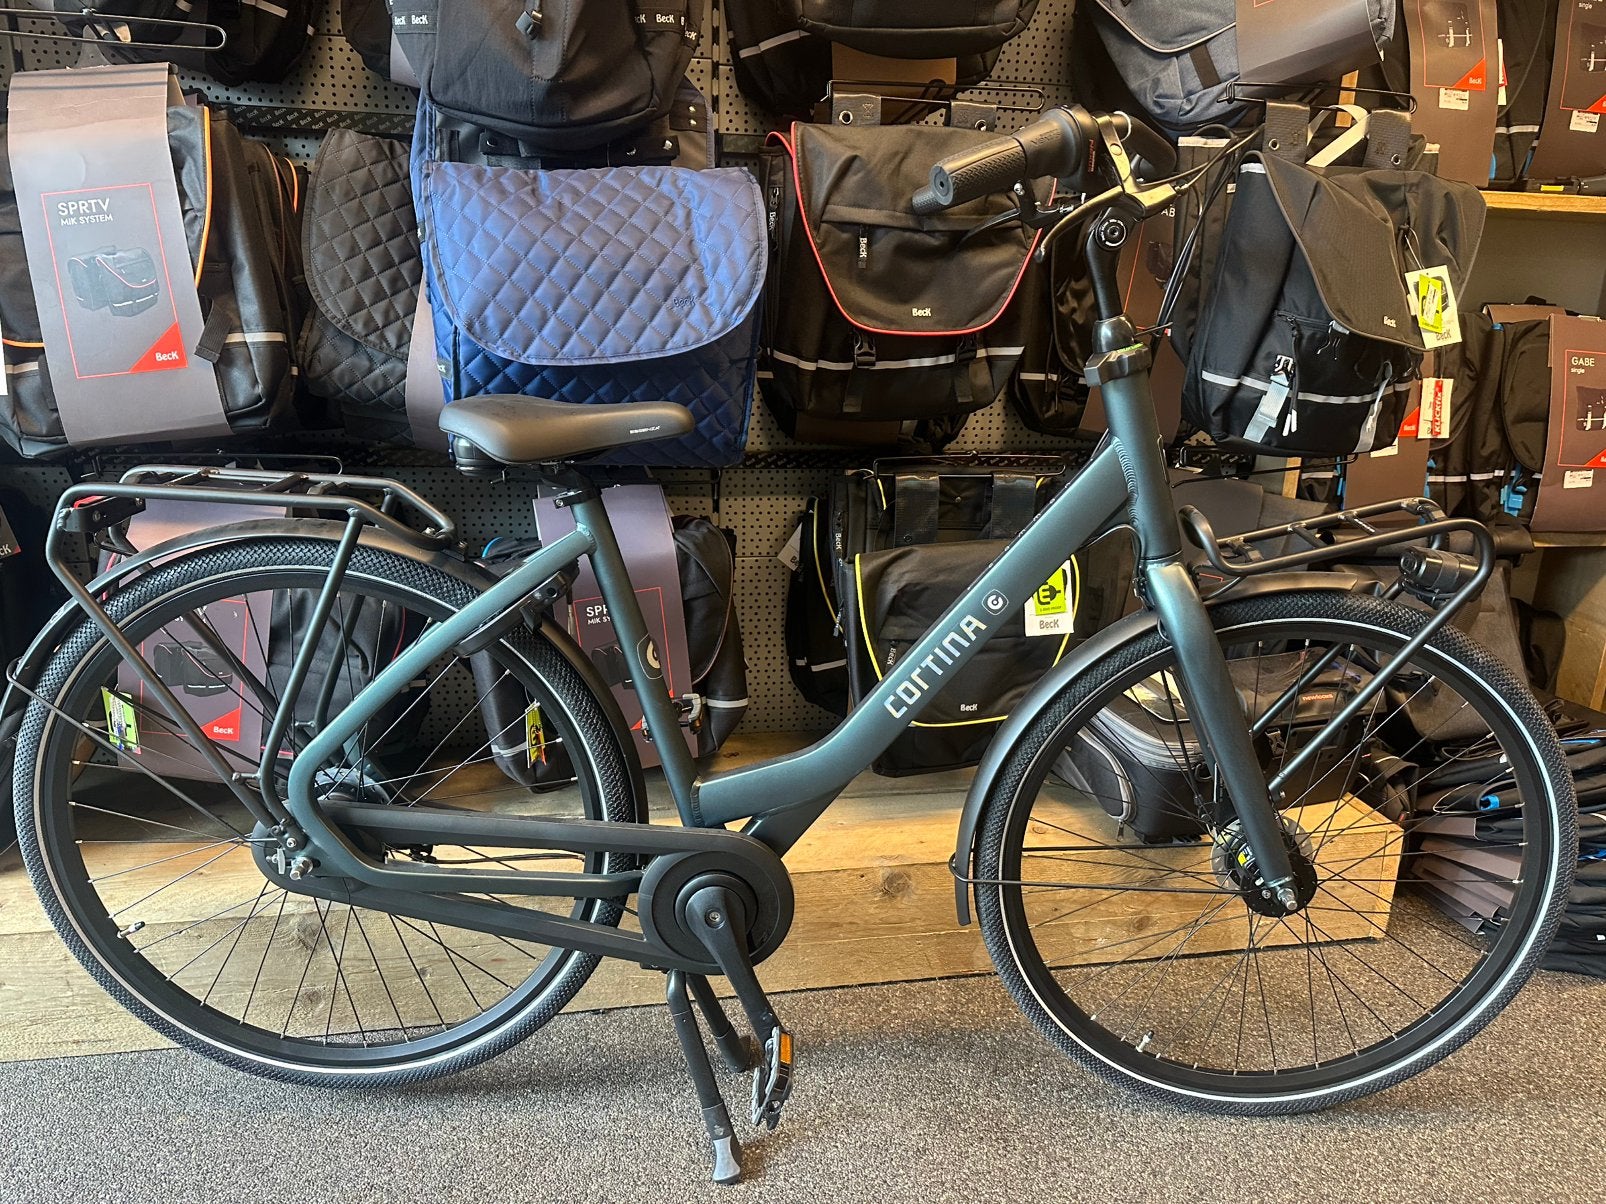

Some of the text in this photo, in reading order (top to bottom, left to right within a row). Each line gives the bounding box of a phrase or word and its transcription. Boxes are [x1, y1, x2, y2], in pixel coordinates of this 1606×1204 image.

[57, 197, 110, 216] SPRTV
[60, 213, 114, 227] MIK SYSTEM
[1571, 356, 1595, 367] GABE
[883, 614, 988, 719] CORTINA
